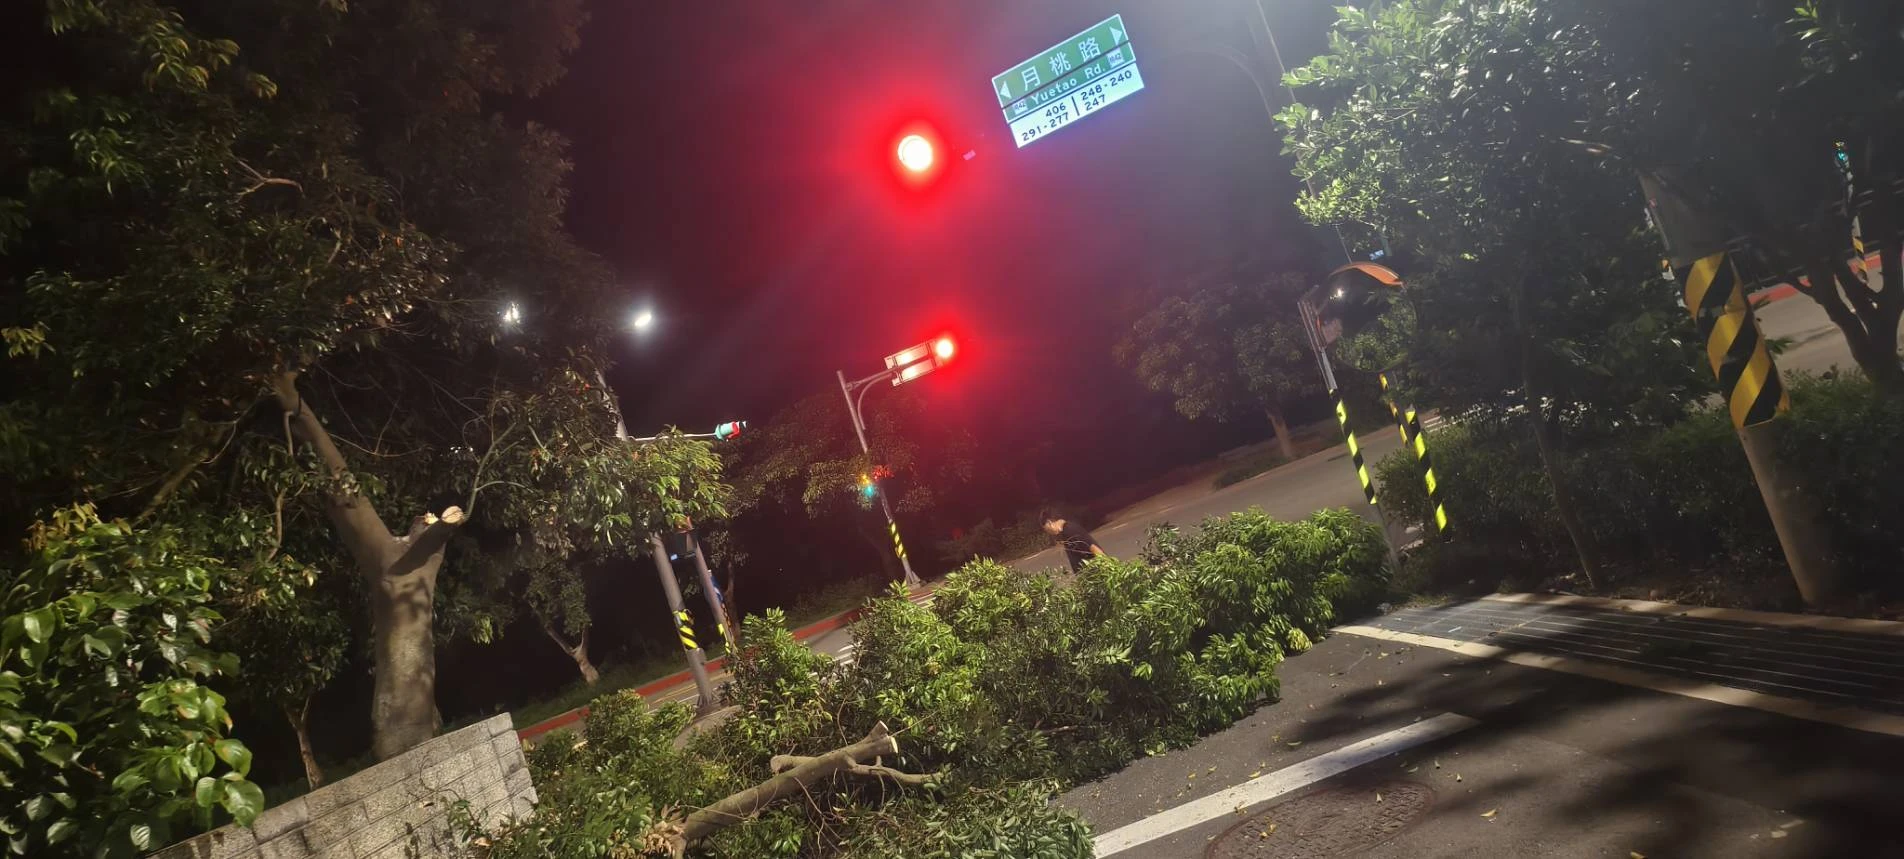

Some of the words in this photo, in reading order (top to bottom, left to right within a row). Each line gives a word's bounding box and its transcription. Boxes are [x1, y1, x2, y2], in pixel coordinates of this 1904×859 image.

[1021, 36, 1101, 91] 月桃路
[1031, 78, 1077, 105] Yuetao
[1084, 64, 1106, 79] Rd.
[1045, 102, 1067, 117] 406
[1084, 94, 1106, 111] 247
